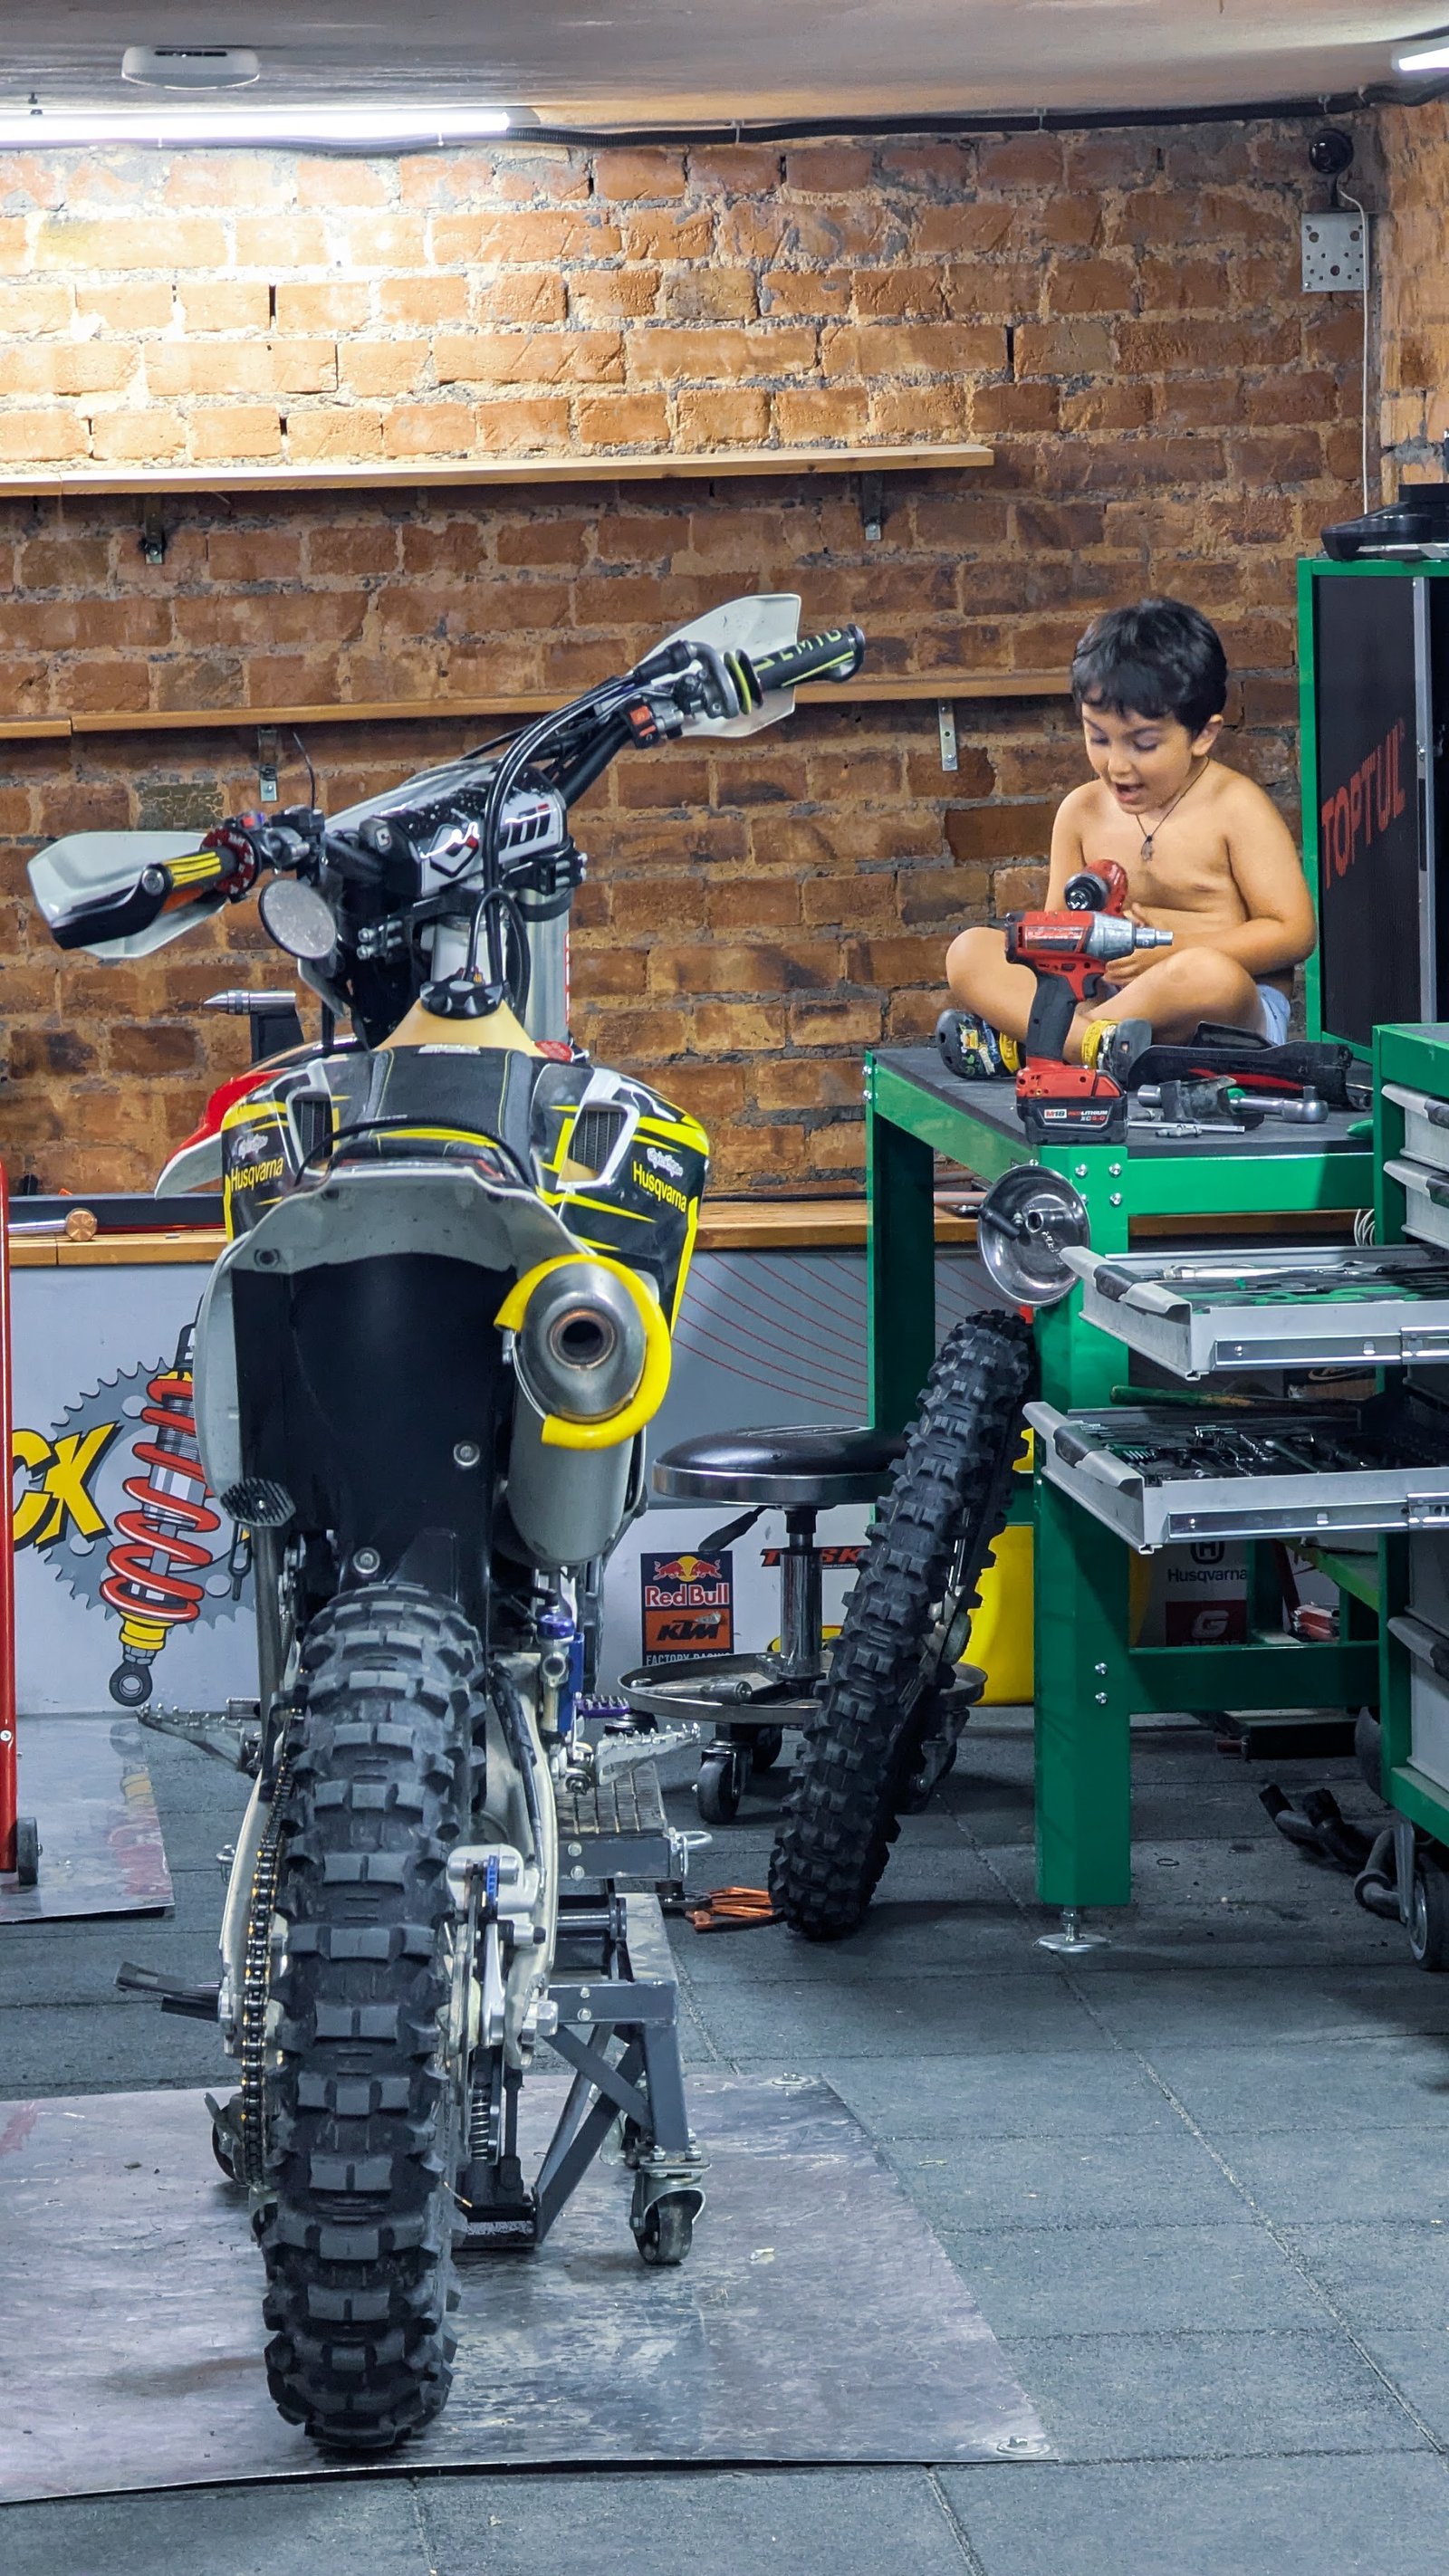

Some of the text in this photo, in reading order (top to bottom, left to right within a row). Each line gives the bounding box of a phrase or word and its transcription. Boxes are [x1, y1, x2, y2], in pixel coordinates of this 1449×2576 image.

[1321, 725, 1405, 890] TOPTUL
[231, 1157, 283, 1192] Husqvarna
[633, 1160, 687, 1212] Husqvarna
[1167, 1568, 1247, 1584] Husqvarna
[645, 1583, 730, 1607] Red Bull
[657, 1619, 720, 1641] KTM
